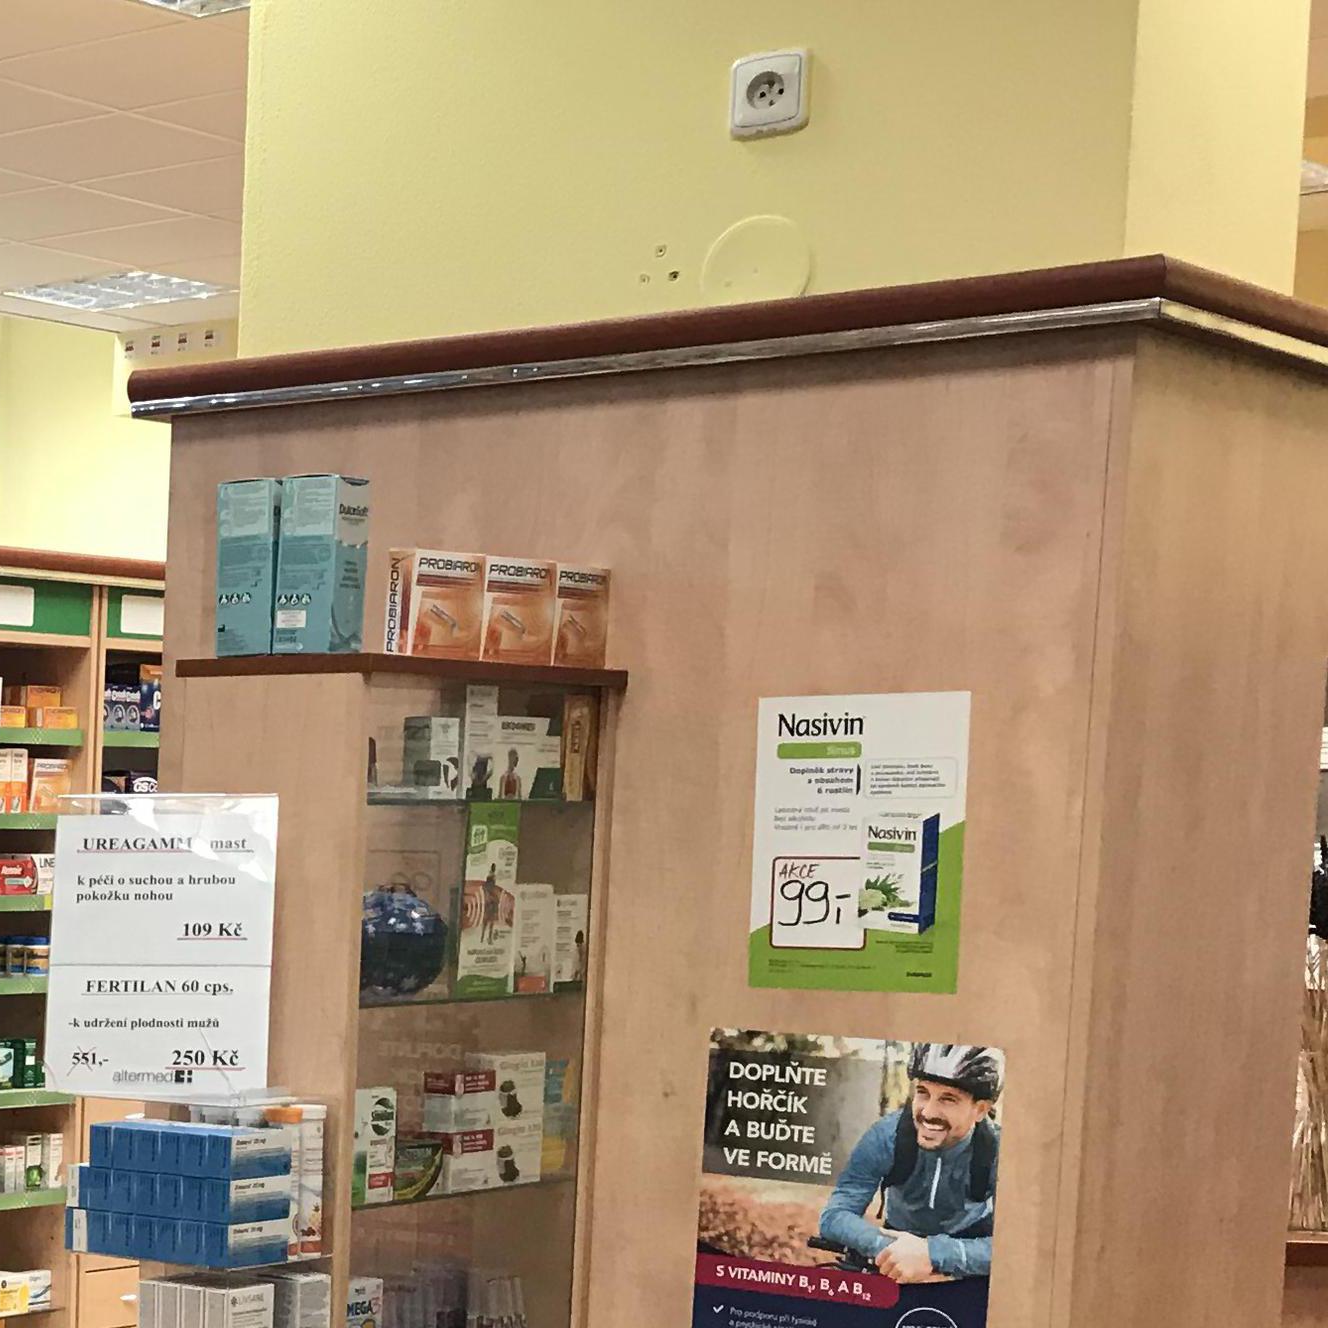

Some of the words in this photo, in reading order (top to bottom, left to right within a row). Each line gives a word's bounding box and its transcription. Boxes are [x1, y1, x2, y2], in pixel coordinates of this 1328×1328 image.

[778, 713, 864, 736] Nasivin
[868, 826, 917, 841] Nasivin
[210, 838, 246, 849] mast
[780, 864, 819, 879] AKCE
[77, 875, 85, 885] k
[89, 874, 114, 889] péči
[118, 877, 125, 885] o
[129, 875, 173, 885] suchou
[177, 877, 184, 885] a
[189, 875, 236, 885] hrubou
[76, 890, 130, 904] pokožku
[134, 891, 173, 901] nohou
[183, 923, 211, 937] 109
[219, 923, 243, 936] Kč
[86, 980, 176, 993] FERTILAN
[182, 980, 200, 992] 60
[204, 981, 234, 996] cps.
[84, 1018, 127, 1028] udržení
[130, 1017, 183, 1030] plodnosti
[188, 1017, 219, 1028] mužů
[173, 1050, 205, 1066] 250
[212, 1050, 239, 1066] Kč
[730, 1062, 827, 1086] DOPLŇTE
[727, 1089, 807, 1114] HOŘČÍK
[724, 1120, 740, 1136] A
[747, 1119, 815, 1144] BUĎTE
[724, 1148, 750, 1166] VE
[757, 1150, 832, 1175] FORMĚ
[716, 1265, 725, 1277] S
[728, 1266, 795, 1286] VITAMINY
[838, 1282, 849, 1293] A
